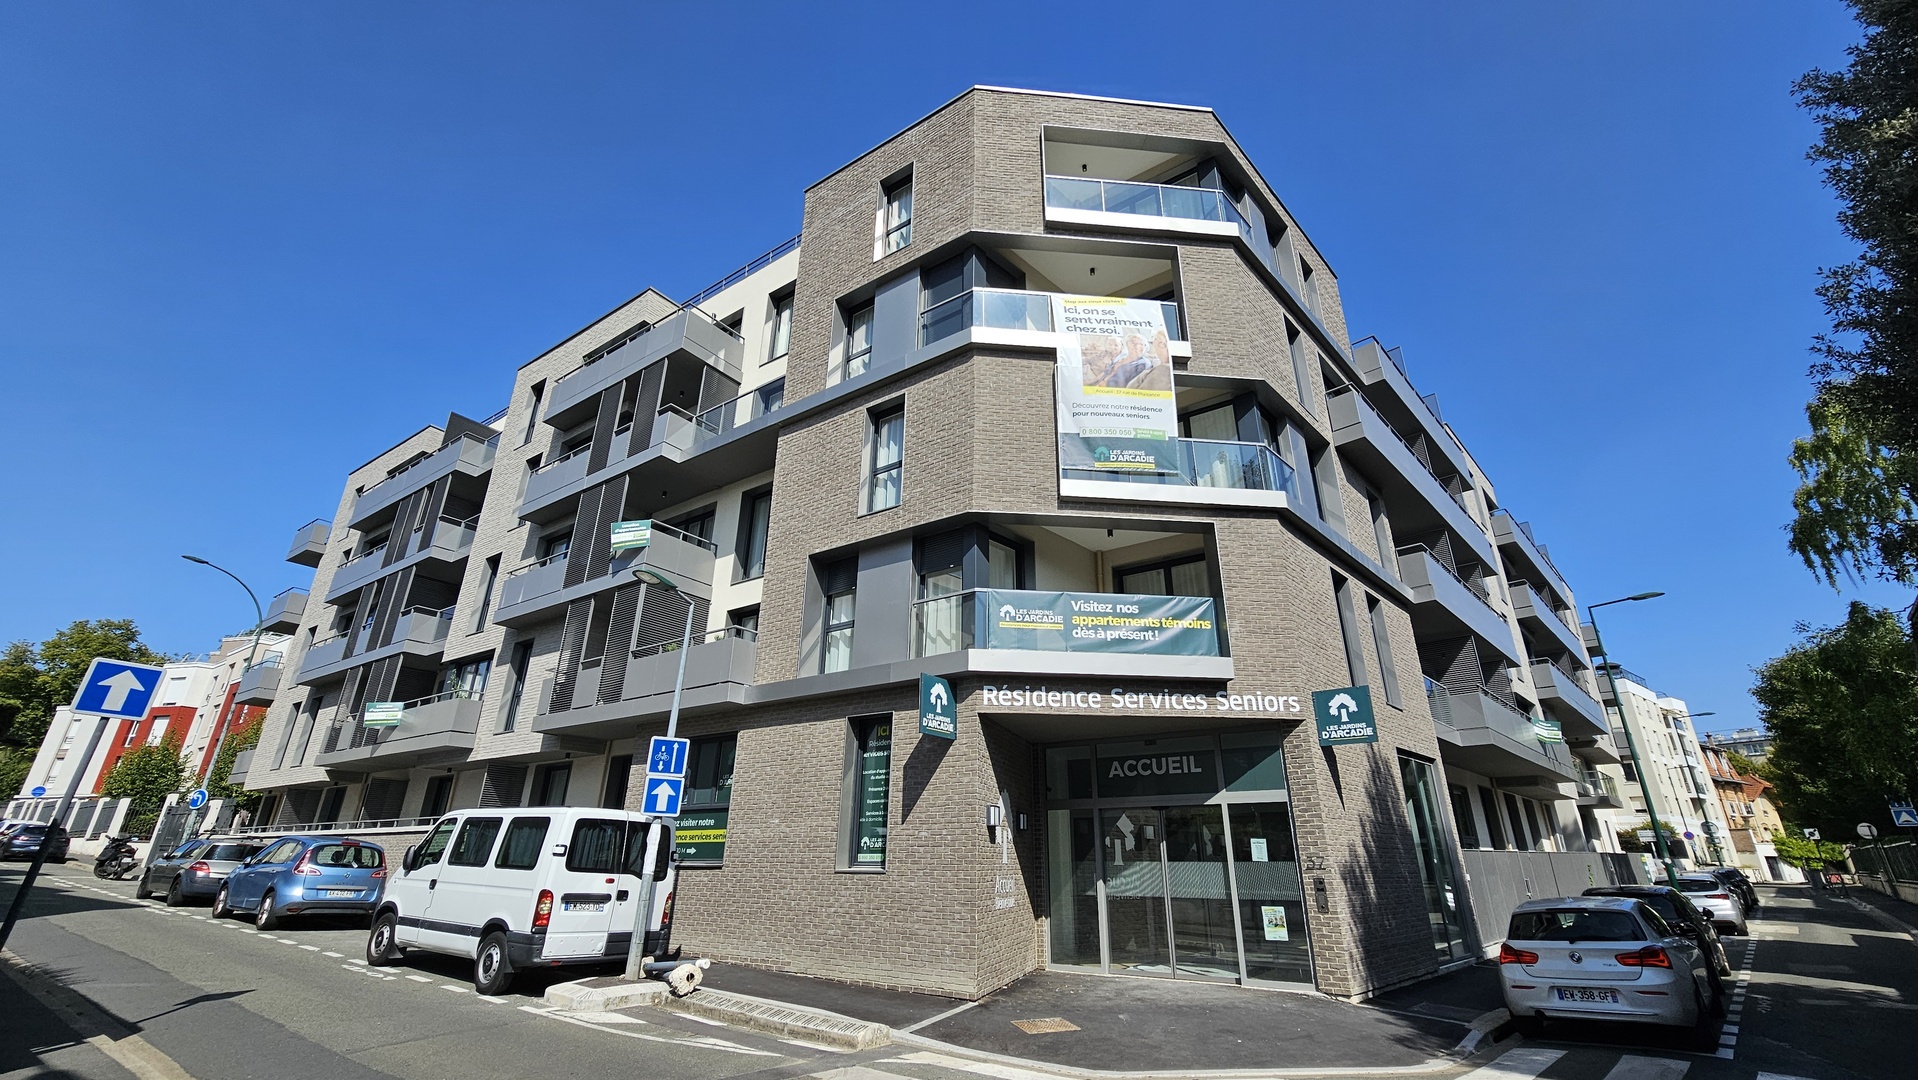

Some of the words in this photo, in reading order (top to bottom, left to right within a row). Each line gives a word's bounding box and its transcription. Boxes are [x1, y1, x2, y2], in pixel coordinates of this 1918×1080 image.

[1064, 306, 1080, 314] Ici,
[1065, 316, 1093, 324] sent
[1095, 317, 1153, 328] vraiment
[1066, 324, 1098, 333] chez
[1099, 326, 1120, 334] soi.
[1110, 455, 1155, 463] D'ARCADIE
[1071, 600, 1112, 613] Visitez
[1117, 603, 1139, 614] nos
[1016, 614, 1063, 623] D'ARCADIE
[1072, 615, 1160, 628] appartements
[1161, 617, 1212, 629] témoins
[1072, 627, 1095, 638] dès
[1097, 628, 1105, 639] à
[982, 684, 1102, 708] Résidence
[1110, 688, 1208, 711] Services
[1216, 690, 1300, 712] Seniors
[923, 718, 954, 732] D'ARCADIE
[878, 726, 889, 736] ICI
[1322, 728, 1374, 739] D'ARCADIE
[1109, 755, 1202, 778] ACCUEIL
[680, 818, 698, 826] visiter
[689, 832, 711, 840] services
[1563, 990, 1610, 1001] EW-358-GF
